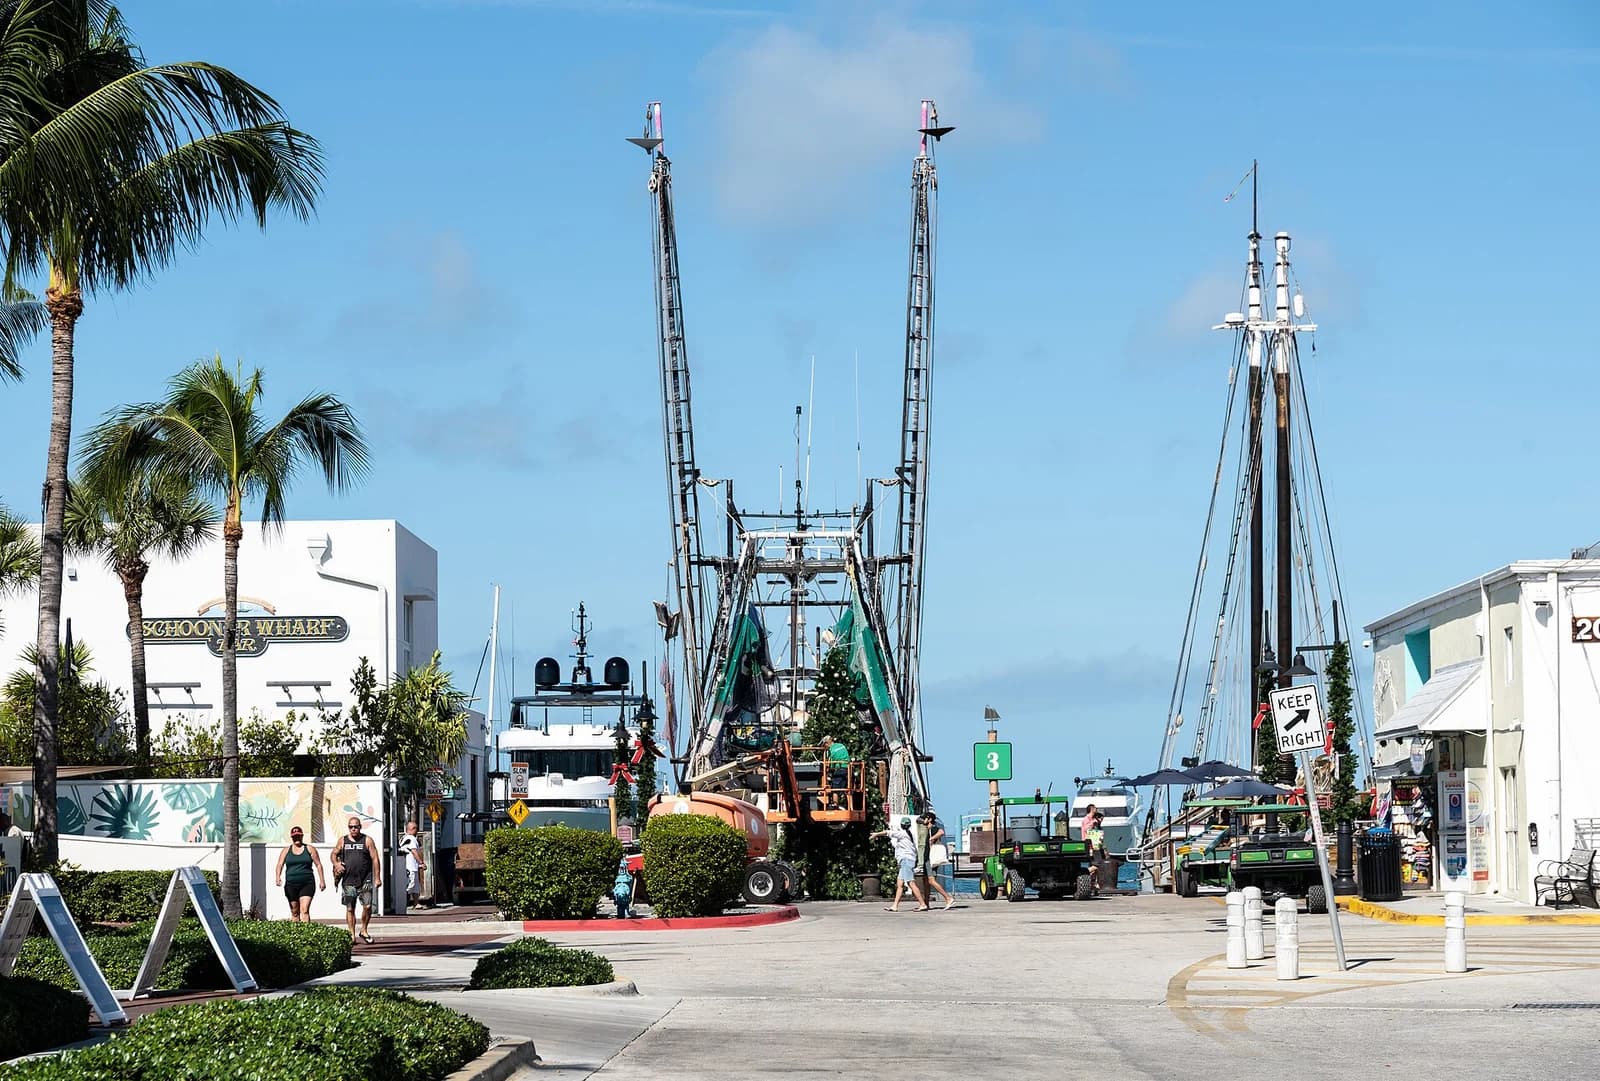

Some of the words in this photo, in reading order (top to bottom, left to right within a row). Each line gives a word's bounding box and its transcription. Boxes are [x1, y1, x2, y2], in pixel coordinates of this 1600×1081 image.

[142, 619, 250, 637] SCHOONR
[256, 618, 335, 636] WHARF
[1278, 693, 1312, 710] KEEP
[1281, 730, 1321, 747] RIGHT
[986, 752, 999, 771] 3
